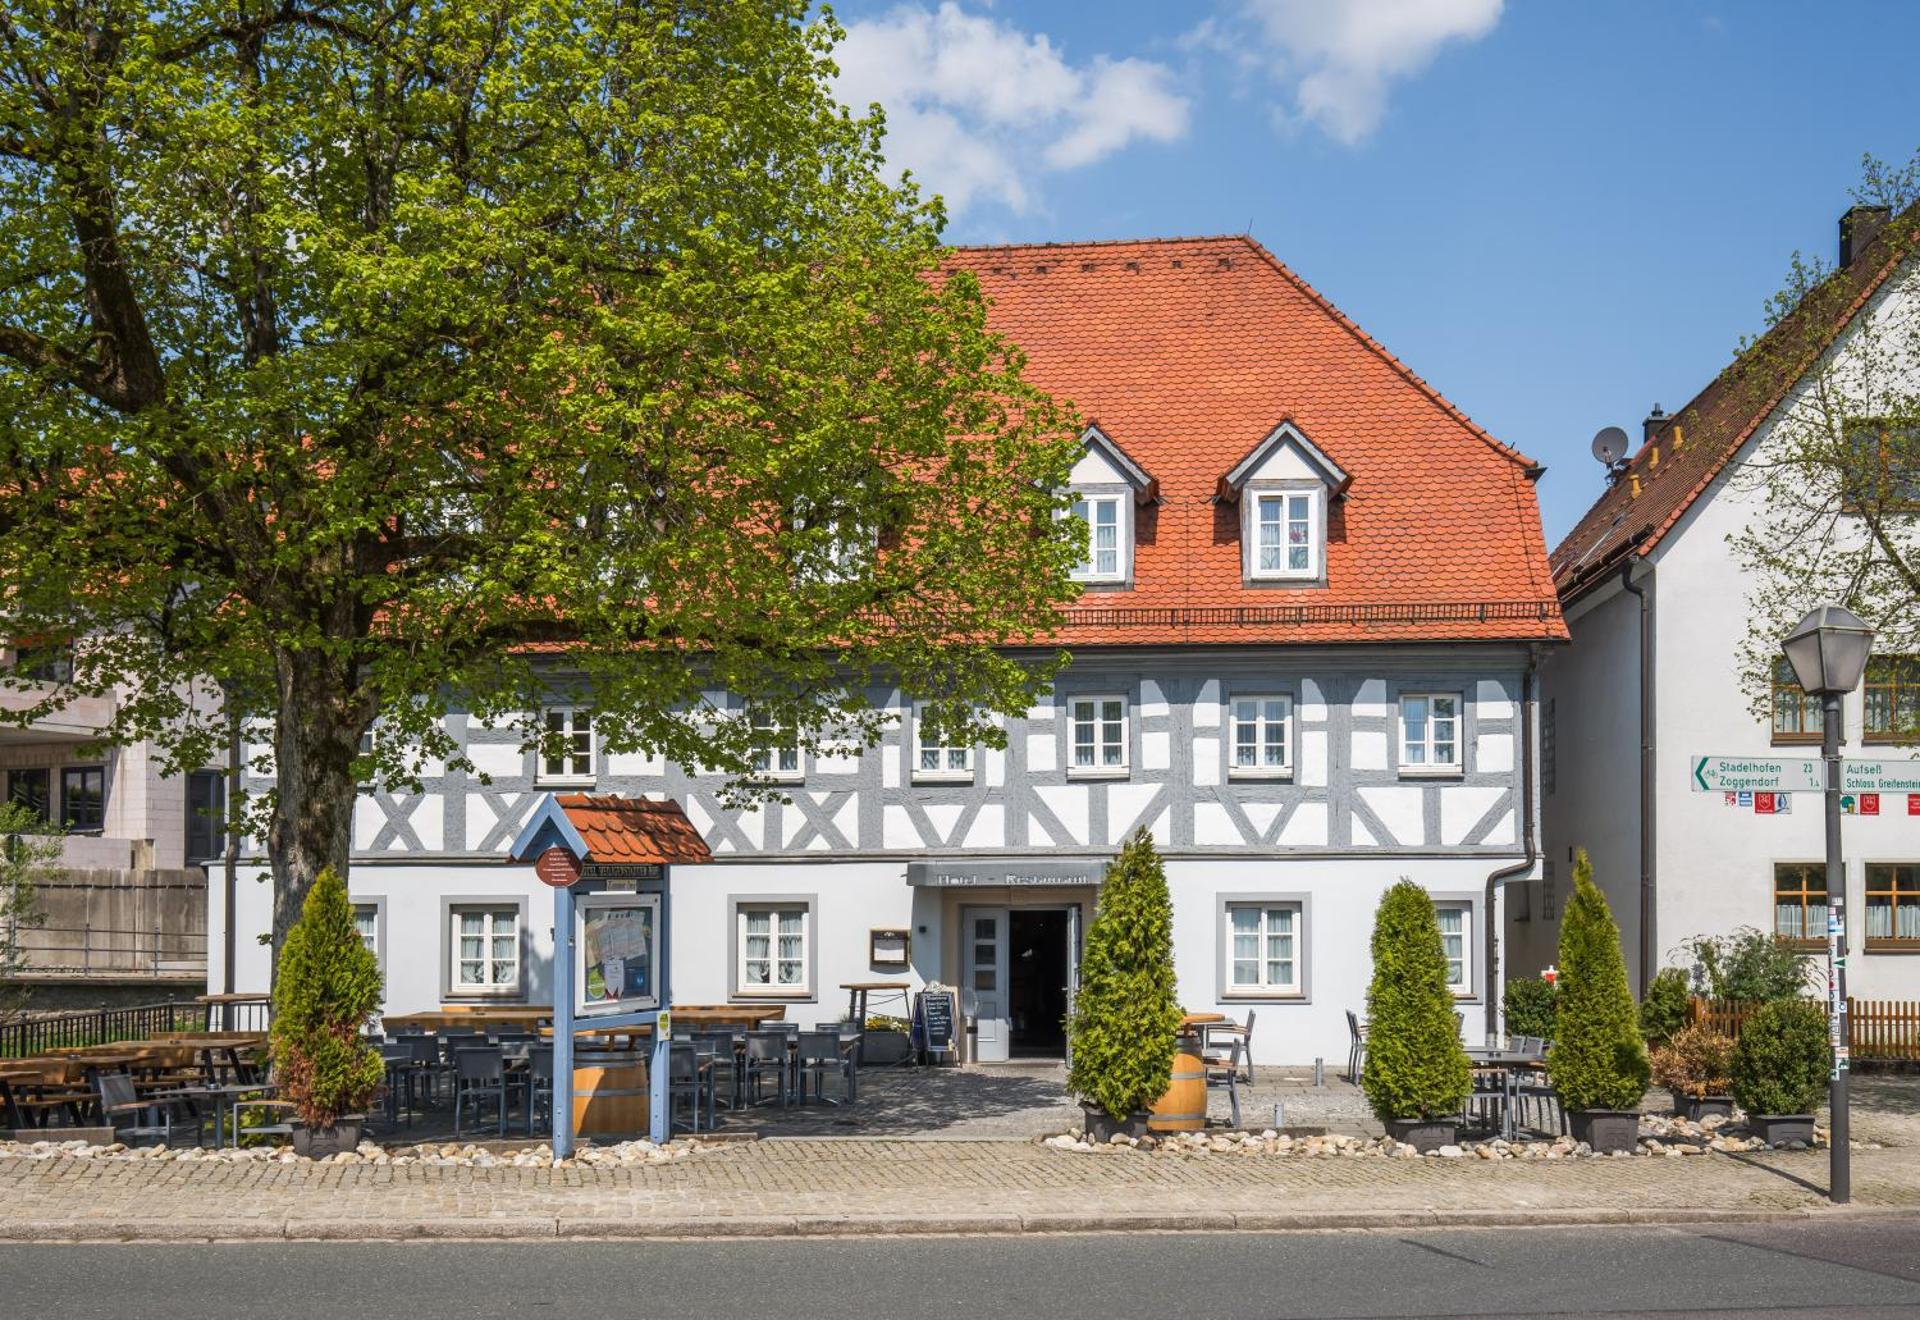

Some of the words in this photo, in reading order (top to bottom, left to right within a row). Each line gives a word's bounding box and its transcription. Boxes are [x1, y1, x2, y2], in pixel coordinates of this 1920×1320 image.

[1719, 762, 1782, 773] Stadelhofen
[1803, 763, 1813, 773] 23
[1846, 764, 1882, 775] Aufseß
[1719, 776, 1780, 788] Zoggendorf
[1846, 778, 1875, 789] Schloss
[1878, 778, 1920, 789] Greifenstei
